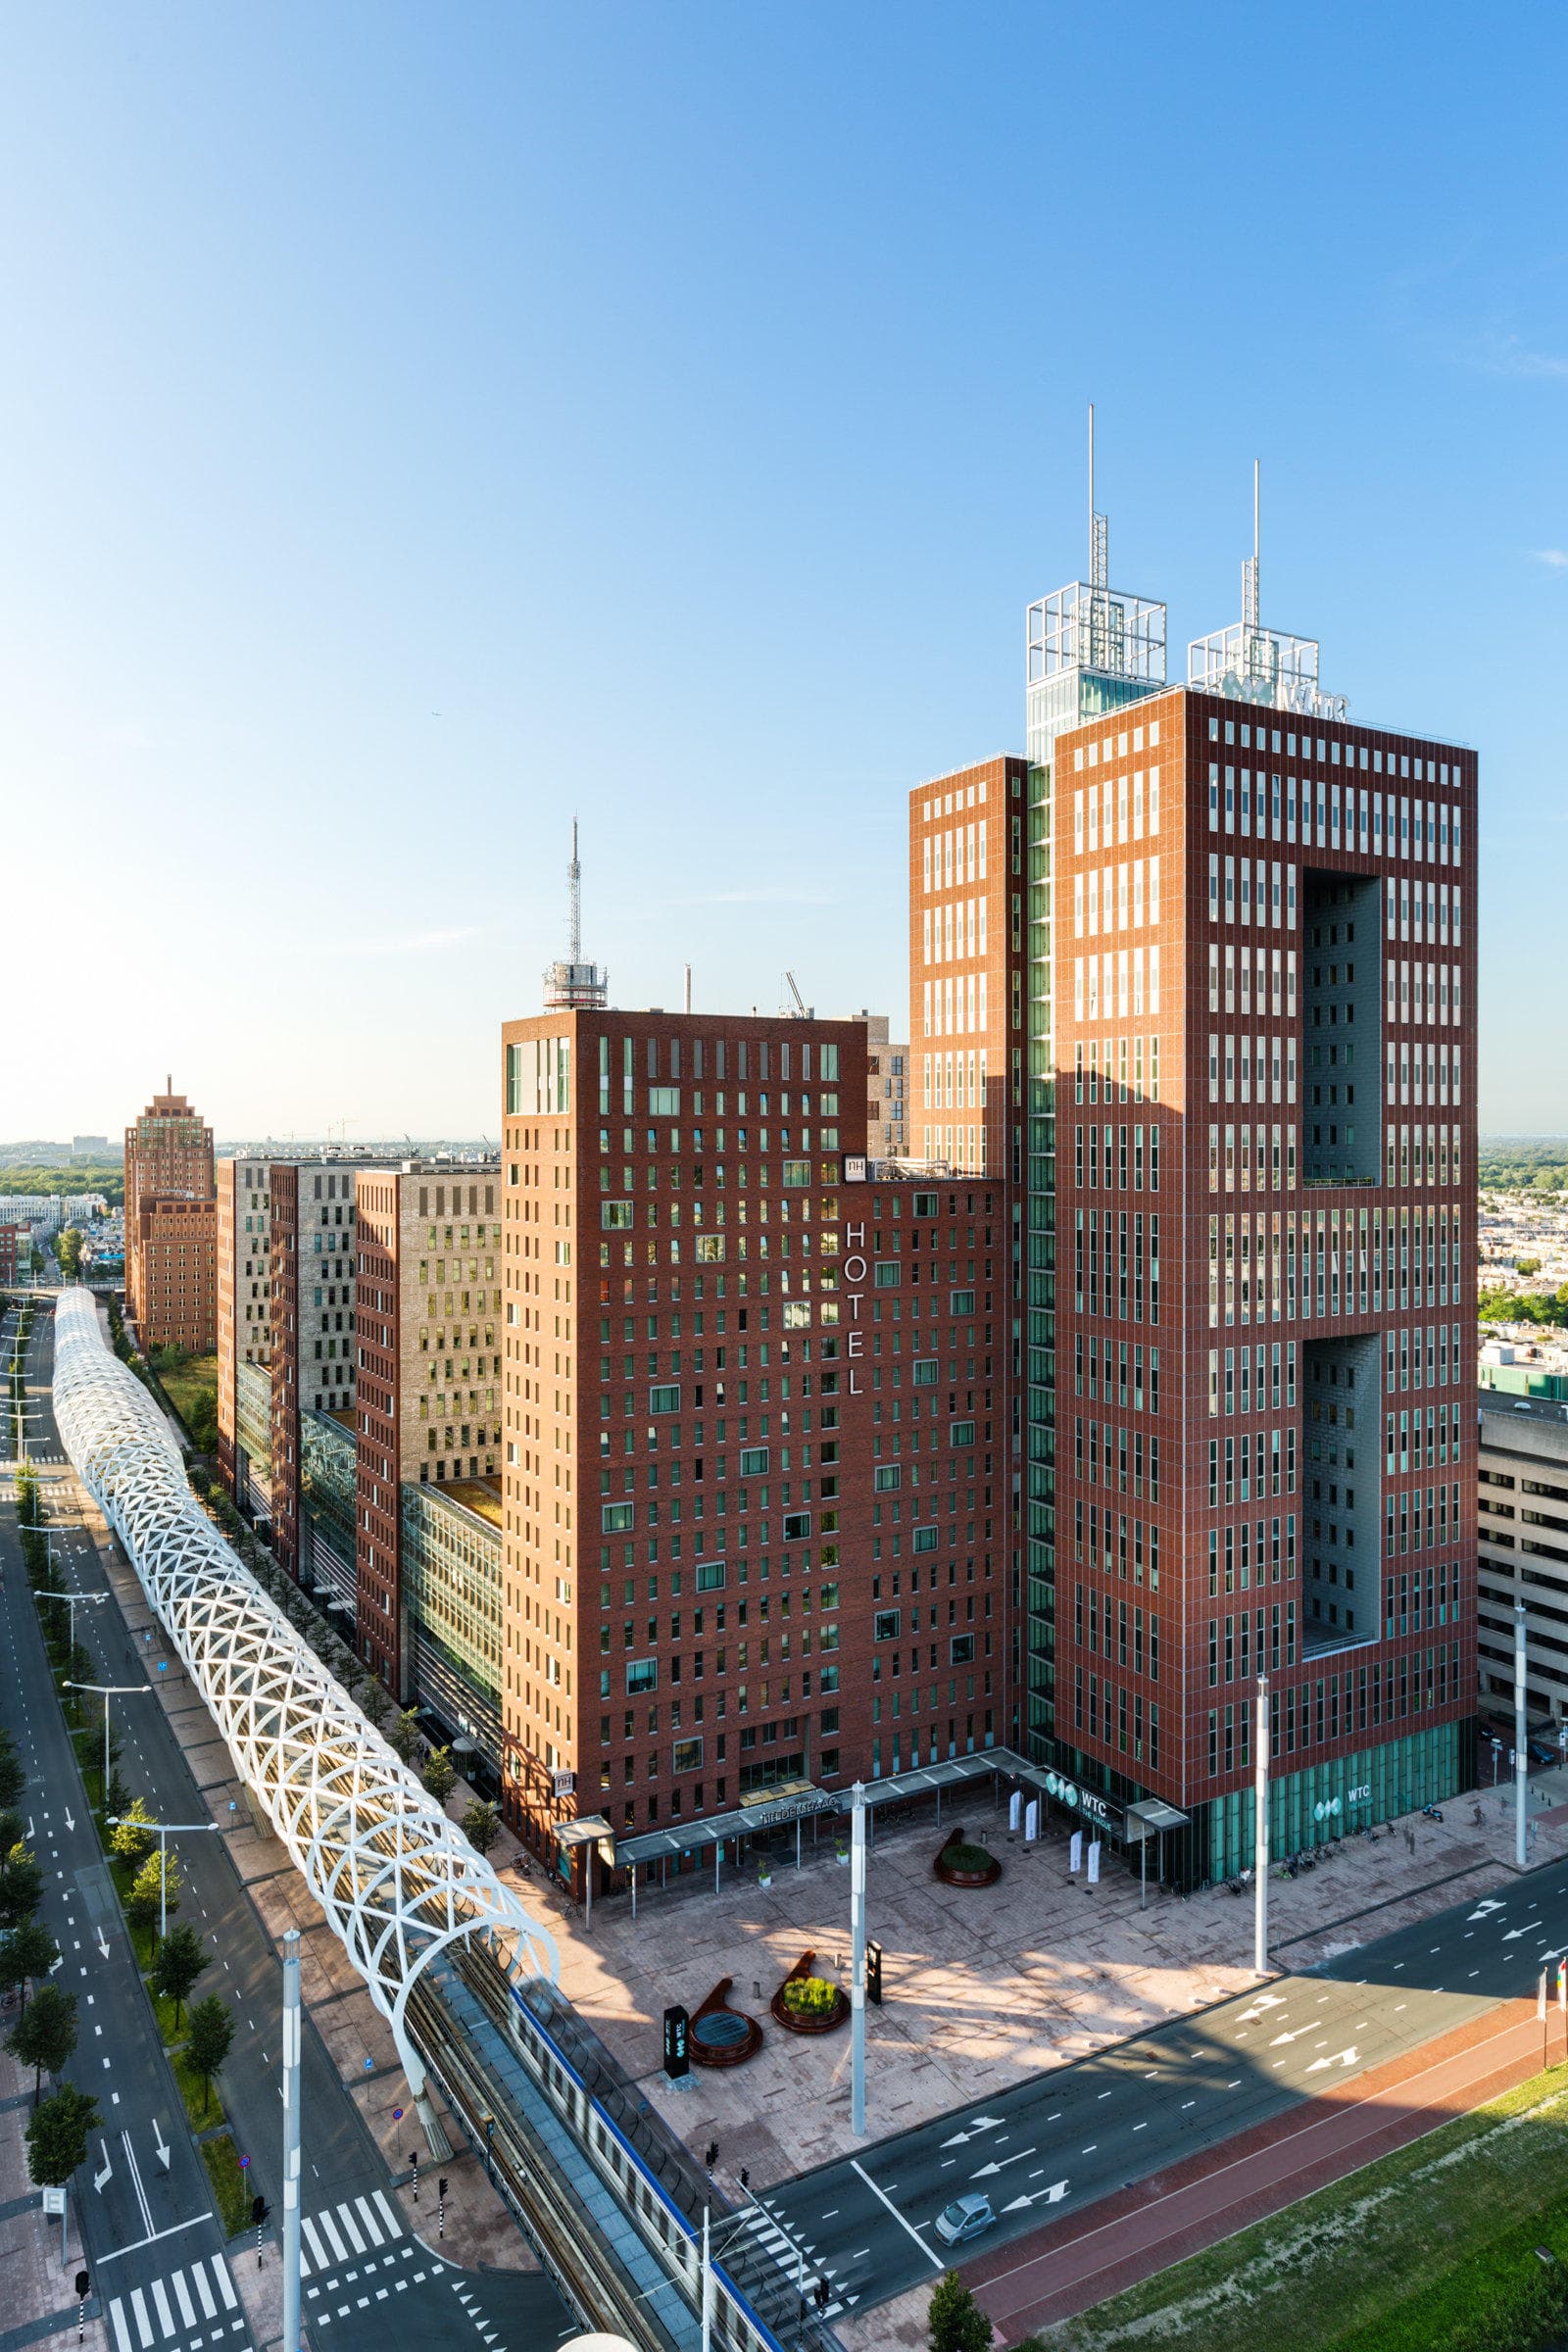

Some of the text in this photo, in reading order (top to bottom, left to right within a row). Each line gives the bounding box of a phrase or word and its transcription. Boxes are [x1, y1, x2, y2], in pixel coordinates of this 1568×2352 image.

[844, 1221, 867, 1395] HOTEL
[1081, 1790, 1106, 1818] WTC
[1348, 1785, 1369, 1802] WTC
